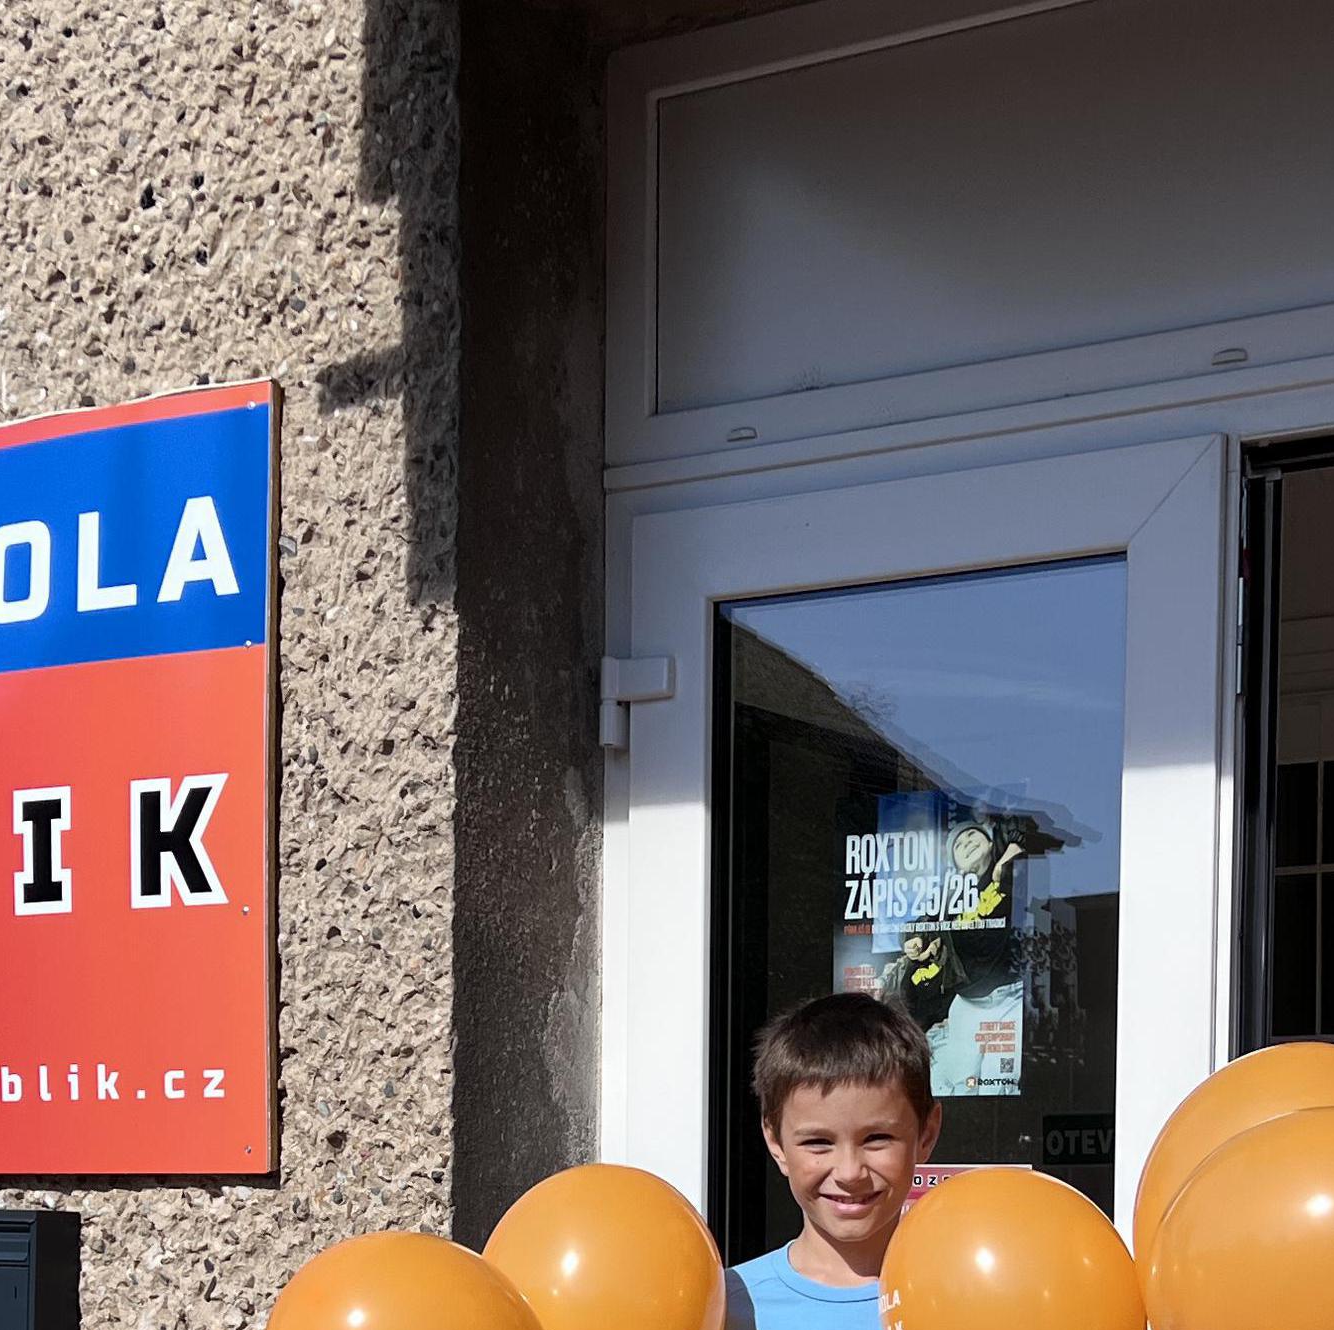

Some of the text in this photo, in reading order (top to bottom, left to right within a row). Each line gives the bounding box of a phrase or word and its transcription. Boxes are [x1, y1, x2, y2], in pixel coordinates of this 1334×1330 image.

[845, 829, 935, 875] ROXTON
[844, 869, 979, 922] ZÁPIS 25/26
[1046, 1129, 1114, 1156] OTEV
